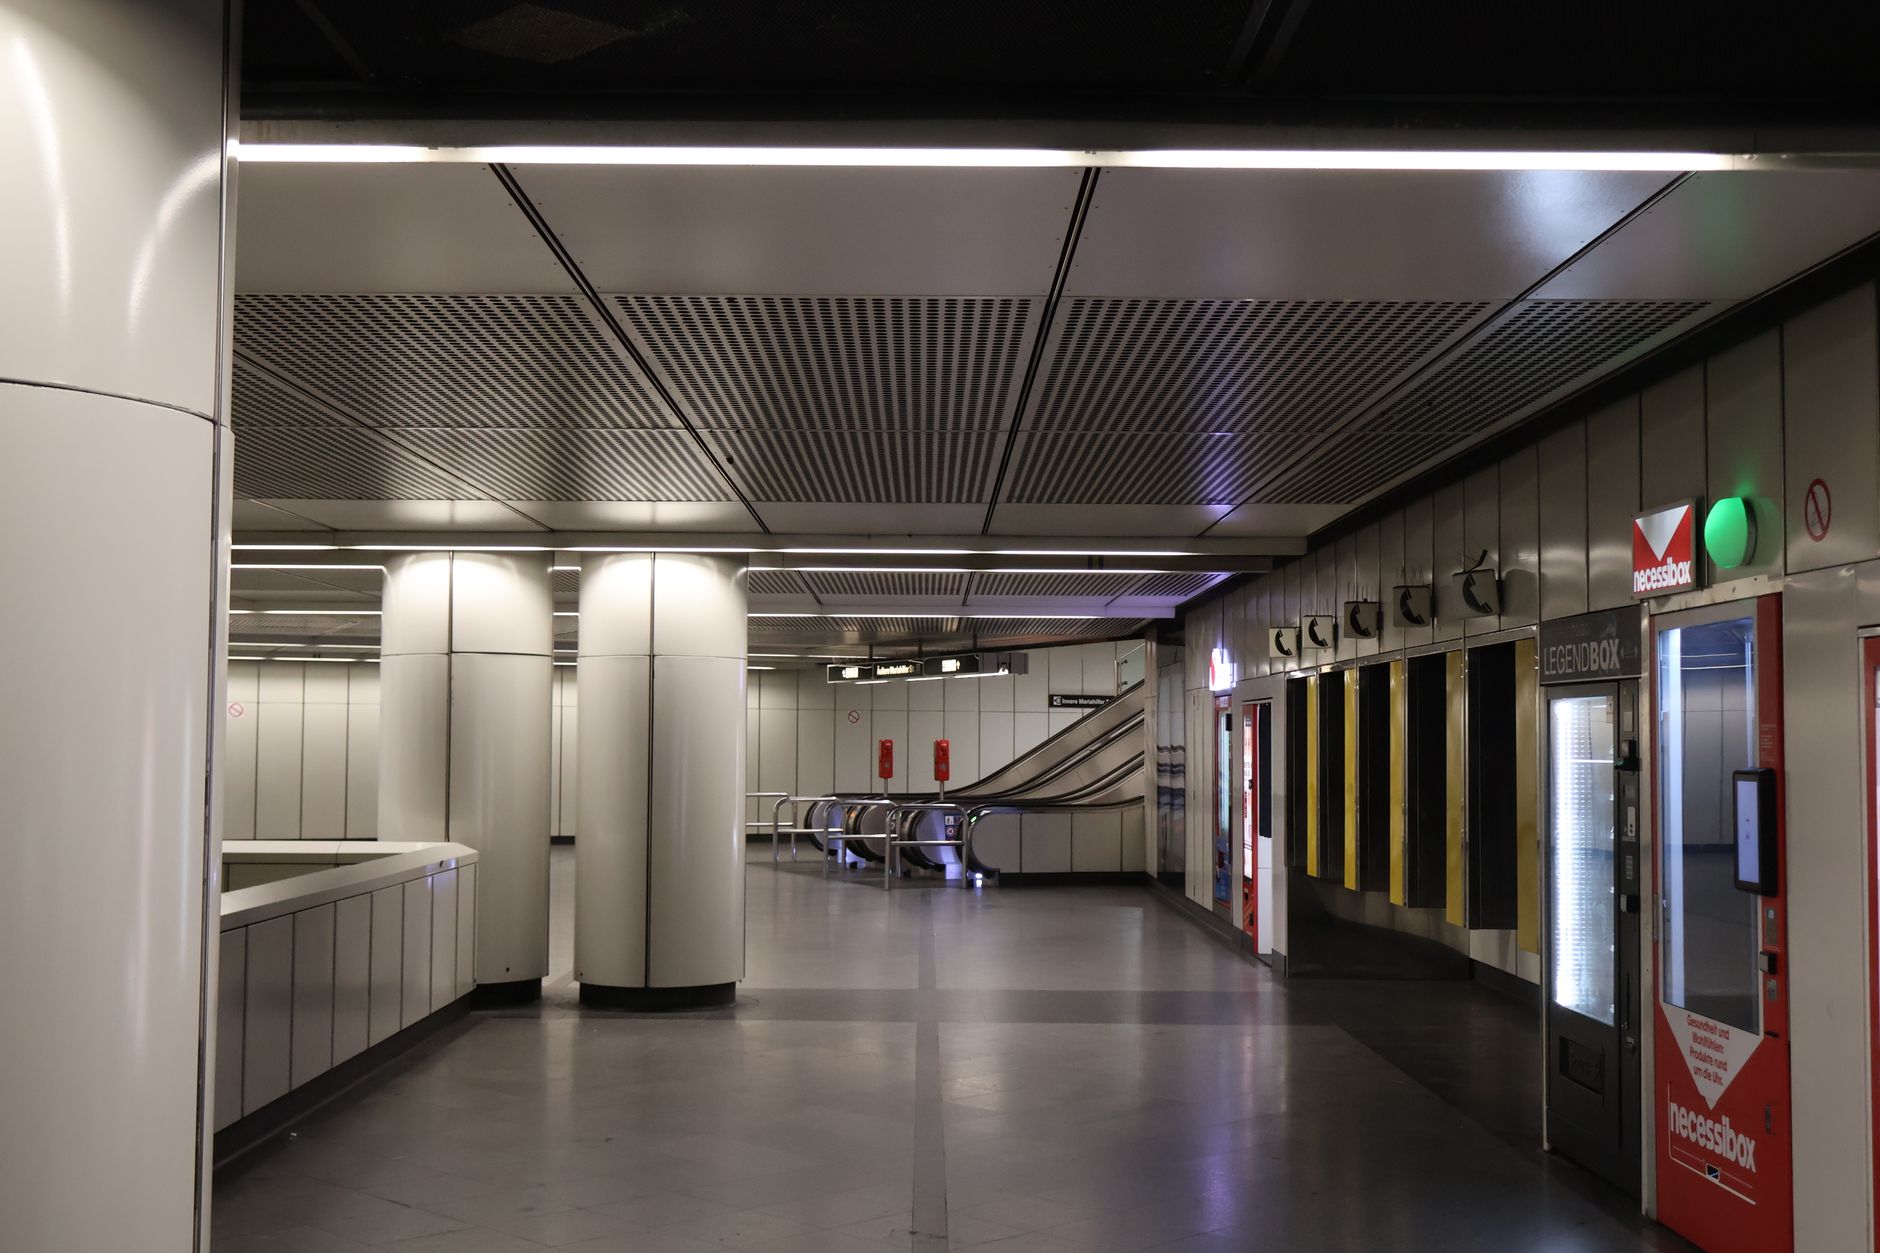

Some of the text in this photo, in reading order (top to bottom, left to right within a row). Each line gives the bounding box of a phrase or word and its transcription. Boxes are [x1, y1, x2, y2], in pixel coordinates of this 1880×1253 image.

[1633, 557, 1691, 592] necessibox
[1544, 639, 1620, 675] LEGENDBOX
[1687, 1014, 1730, 1041] Gesundheit und
[1689, 1045, 1728, 1072] Produkte rund
[1693, 1066, 1703, 1077] um
[1702, 1067, 1712, 1081] die
[1670, 1102, 1757, 1173] necessibox
